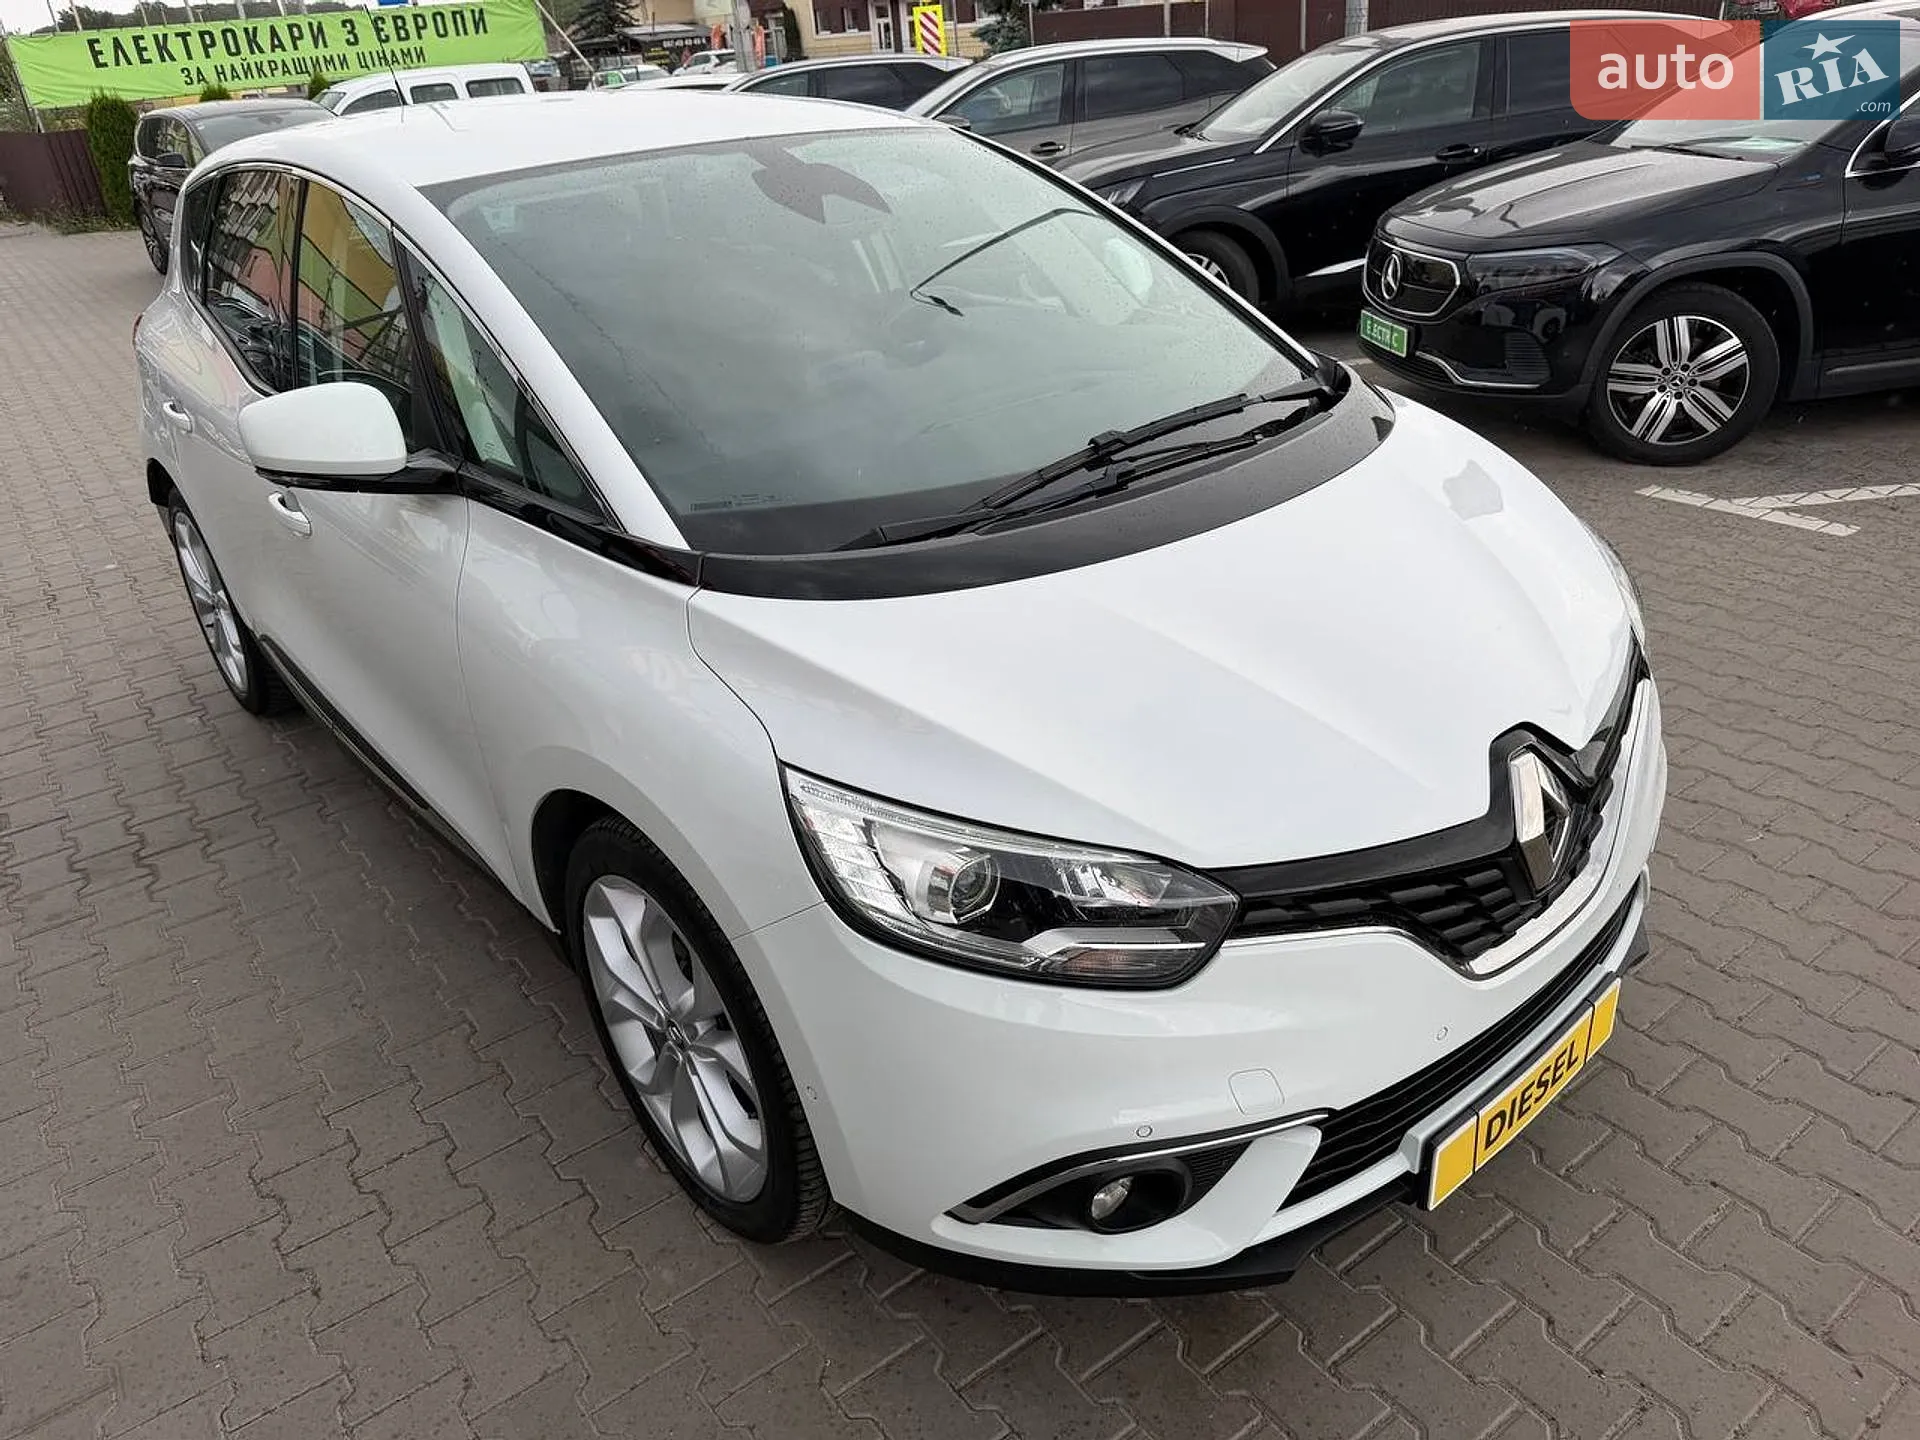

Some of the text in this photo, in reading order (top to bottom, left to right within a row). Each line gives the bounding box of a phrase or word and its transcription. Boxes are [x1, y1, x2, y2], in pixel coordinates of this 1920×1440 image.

[87, 7, 489, 69] ЕЛЕКТРОКАРИ З ЄВРОПИ
[180, 46, 427, 86] ЗА НАЙКРАЩИМИ ЦІНАМИ
[1484, 1040, 1579, 1151] DIESEL
